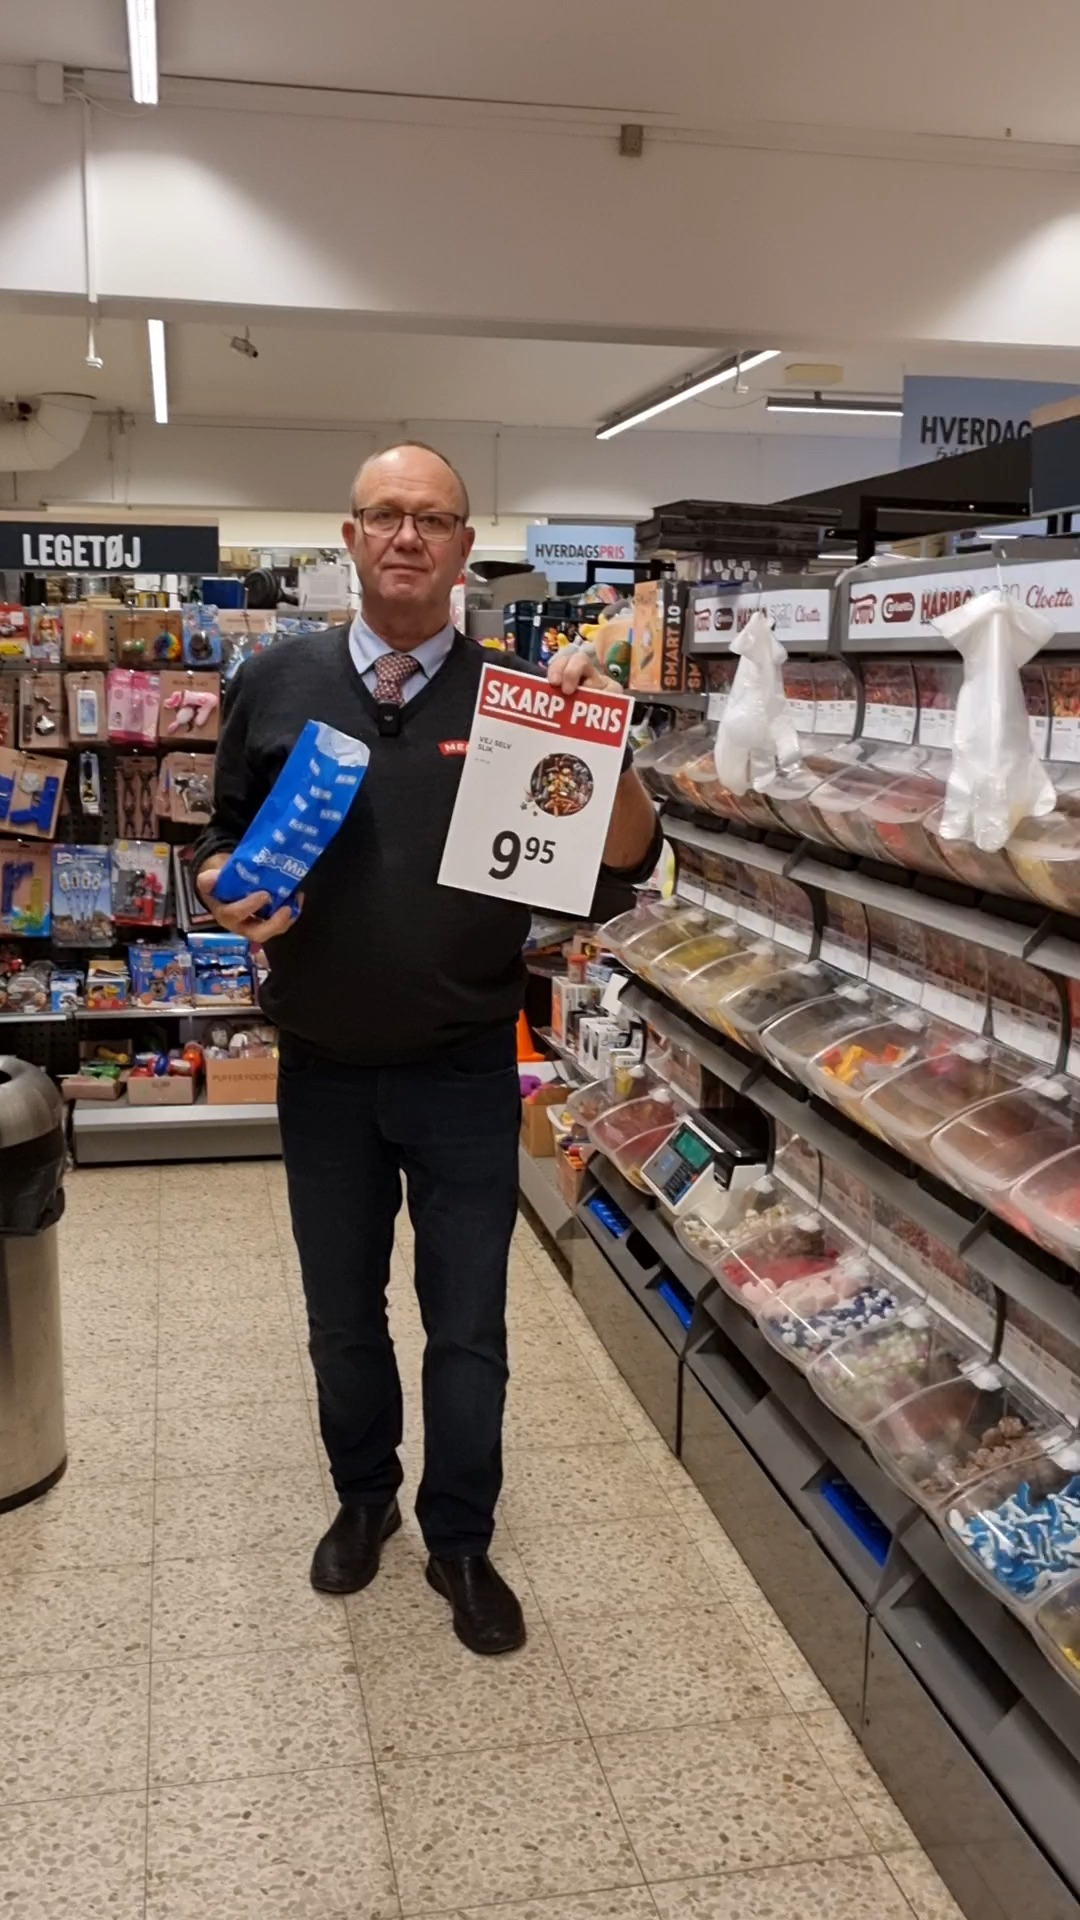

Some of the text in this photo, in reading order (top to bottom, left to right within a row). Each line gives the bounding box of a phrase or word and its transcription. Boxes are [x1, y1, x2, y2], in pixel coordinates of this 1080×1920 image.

[22, 533, 141, 569] LEGETØJ
[1026, 584, 1074, 609] Cloetta
[664, 605, 681, 686] SMART 10
[485, 679, 623, 733] SKARP PRIS
